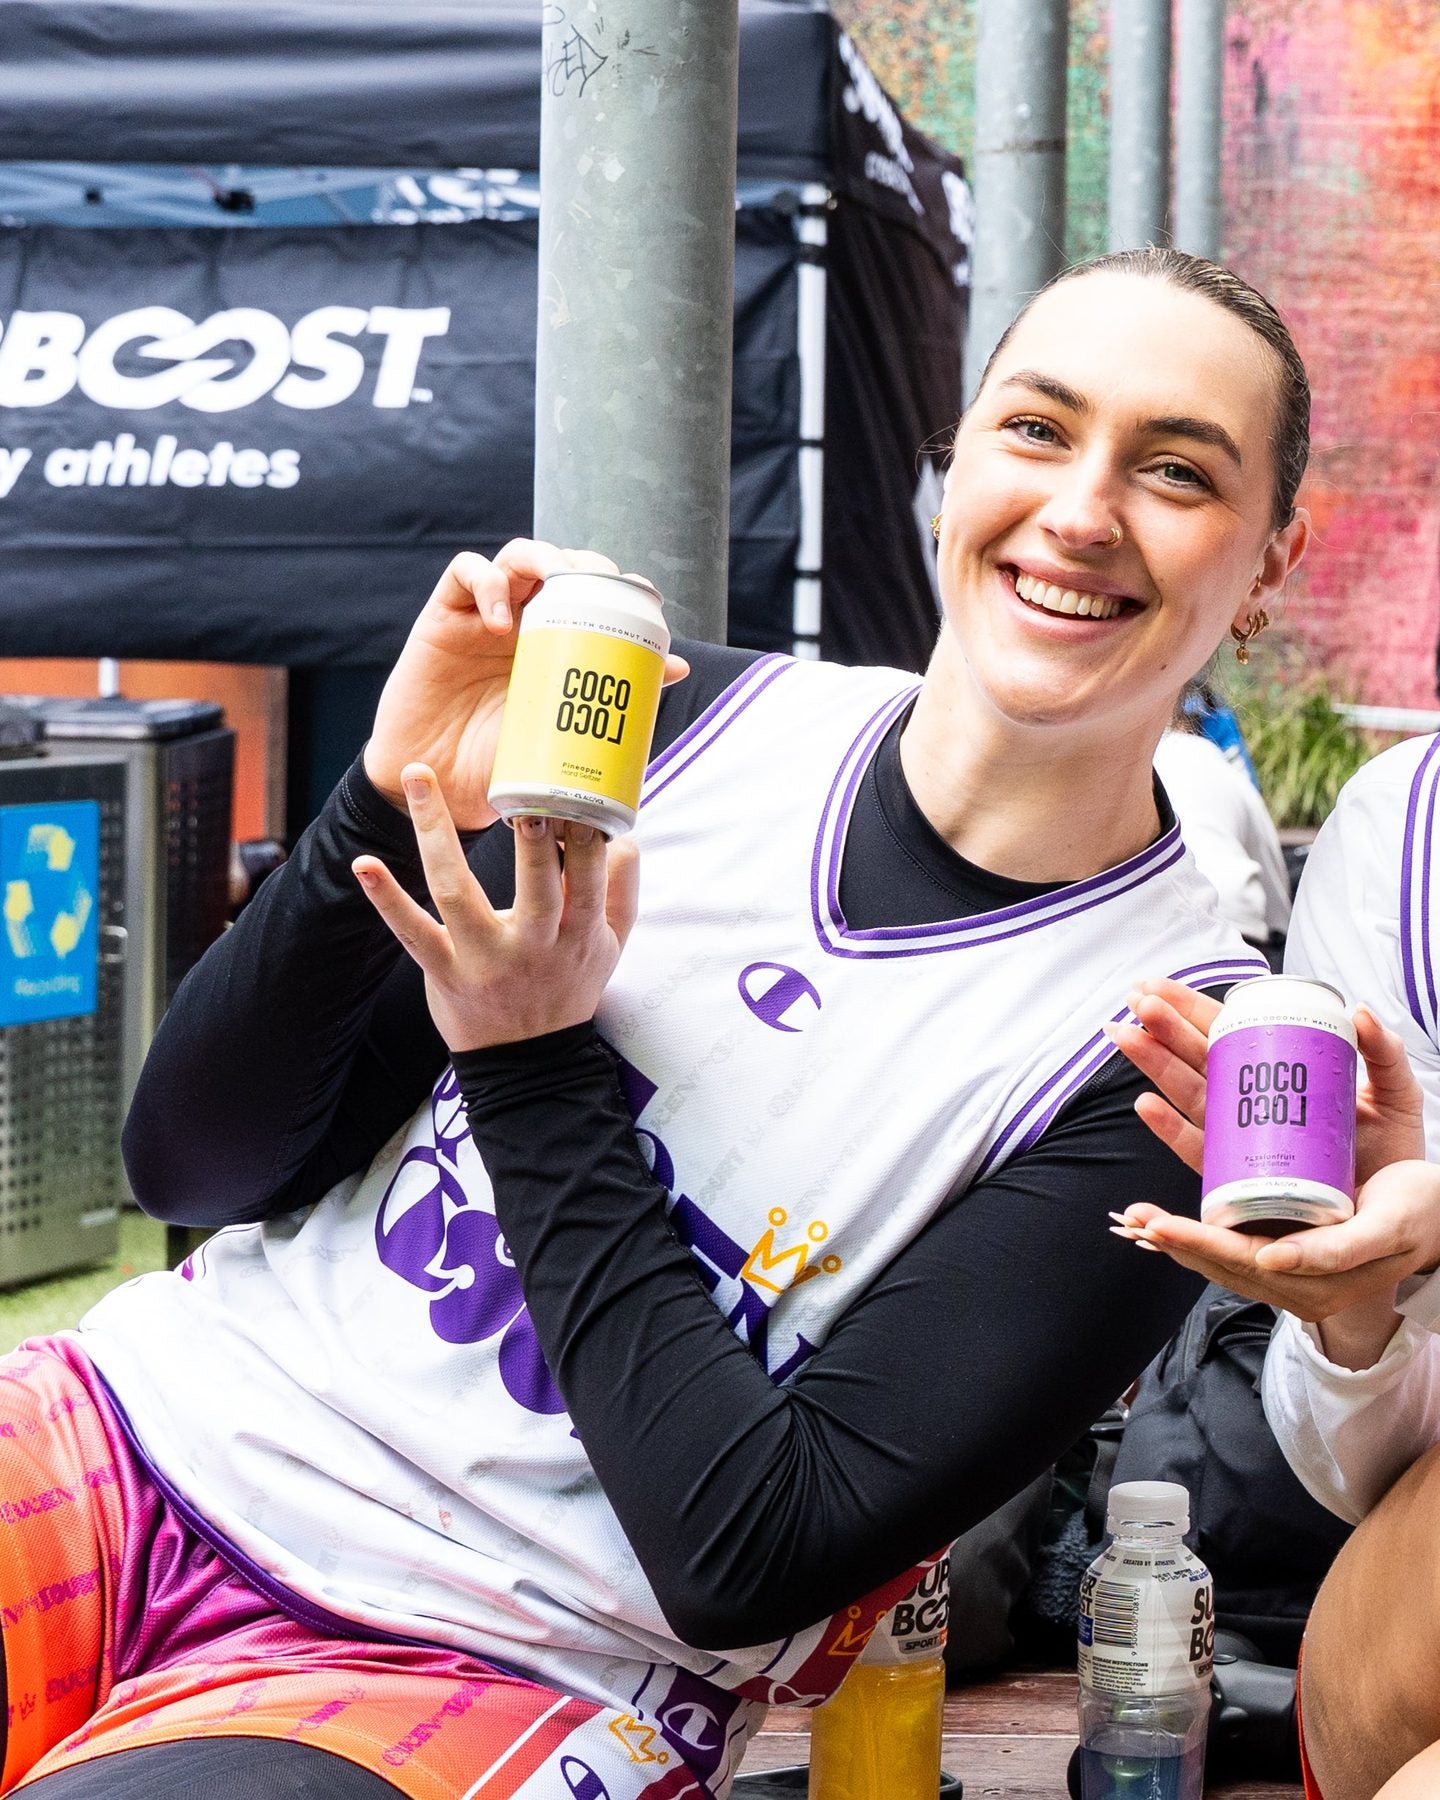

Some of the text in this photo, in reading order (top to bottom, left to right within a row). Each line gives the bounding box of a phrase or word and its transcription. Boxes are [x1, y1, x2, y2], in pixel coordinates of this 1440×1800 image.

[0, 306, 451, 412] BOOST
[44, 434, 300, 488] athletes
[572, 620, 594, 628] WITH
[599, 624, 640, 640] COCONUT
[643, 638, 662, 651] WATER
[563, 667, 631, 712] COCO
[562, 762, 602, 776] Pineapple
[1312, 1018, 1338, 1031] WATER
[1238, 1061, 1307, 1096] COCO
[904, 1636, 938, 1651] SPORT
